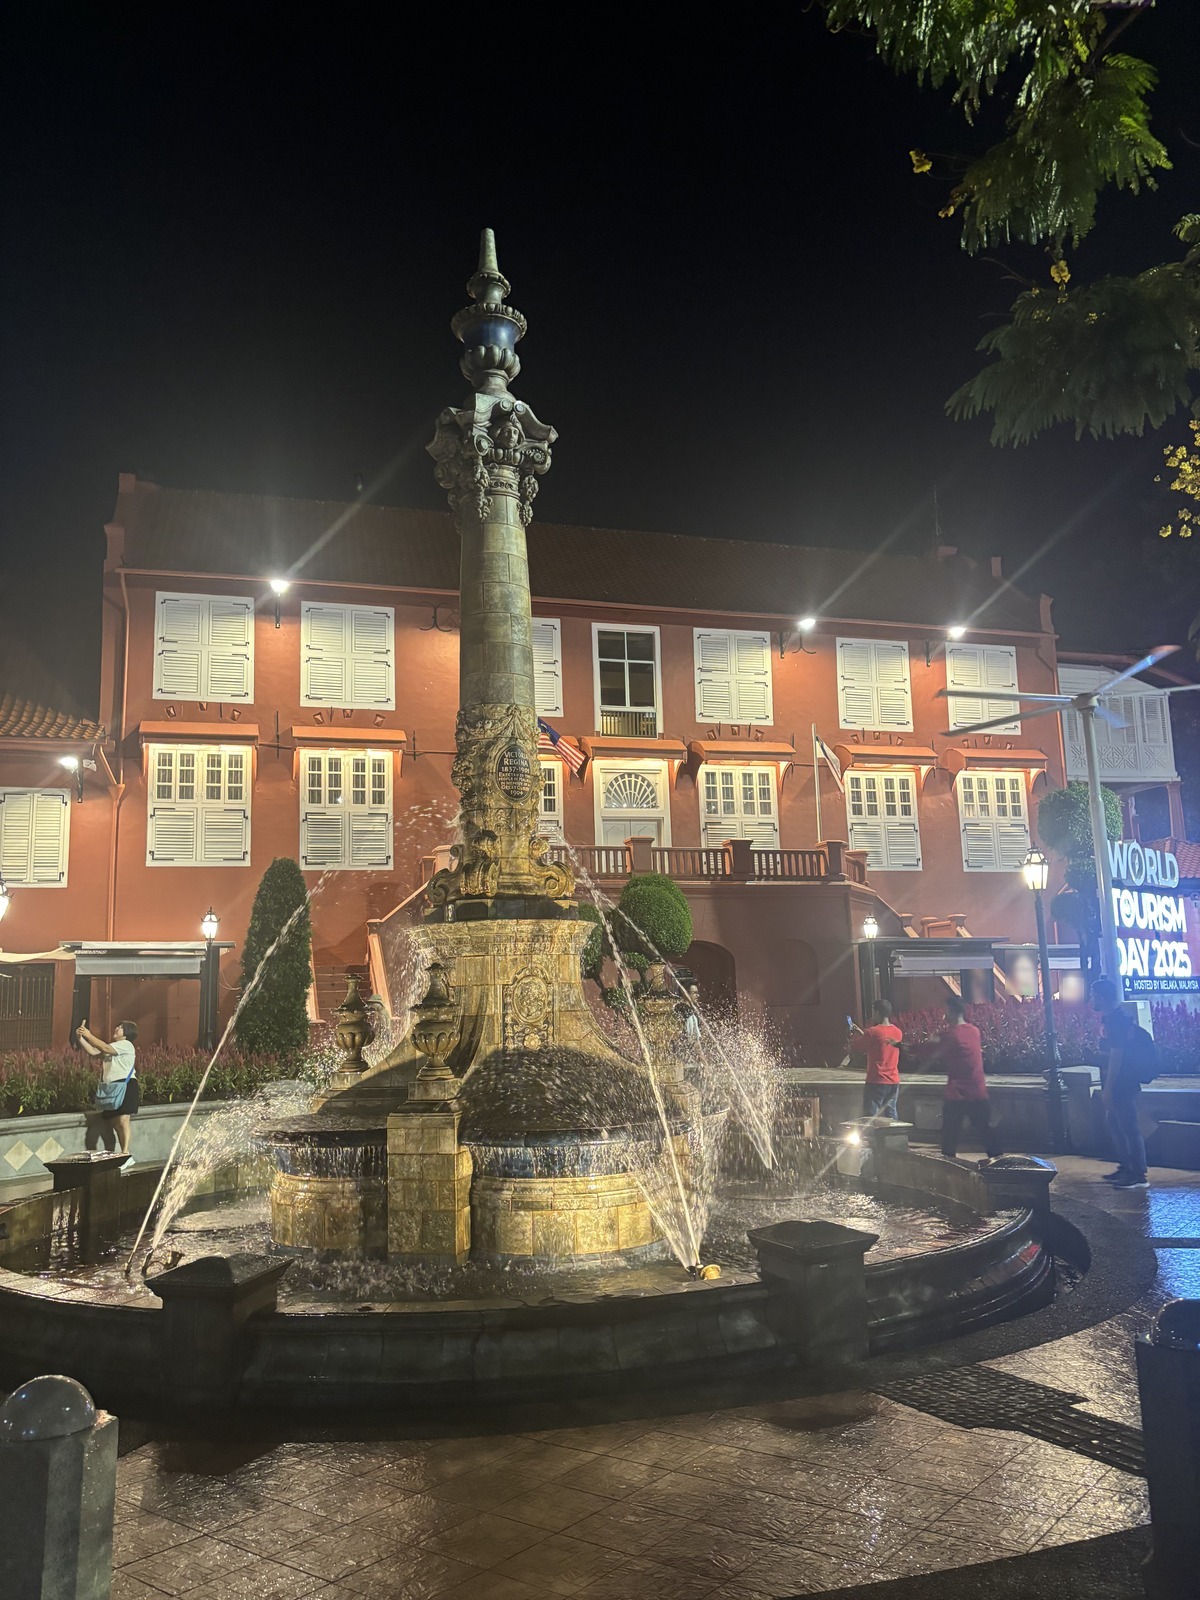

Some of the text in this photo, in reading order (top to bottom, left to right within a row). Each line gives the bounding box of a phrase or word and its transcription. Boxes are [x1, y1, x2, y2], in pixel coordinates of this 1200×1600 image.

[504, 758, 528, 767] REGINA
[1107, 839, 1179, 888] WORLD
[1111, 887, 1187, 933] TOURISM
[1151, 939, 1192, 977] 2025
[1133, 980, 1153, 990] HOSTED
[1153, 980, 1160, 990] BY
[1160, 980, 1179, 991] MELAKA,
